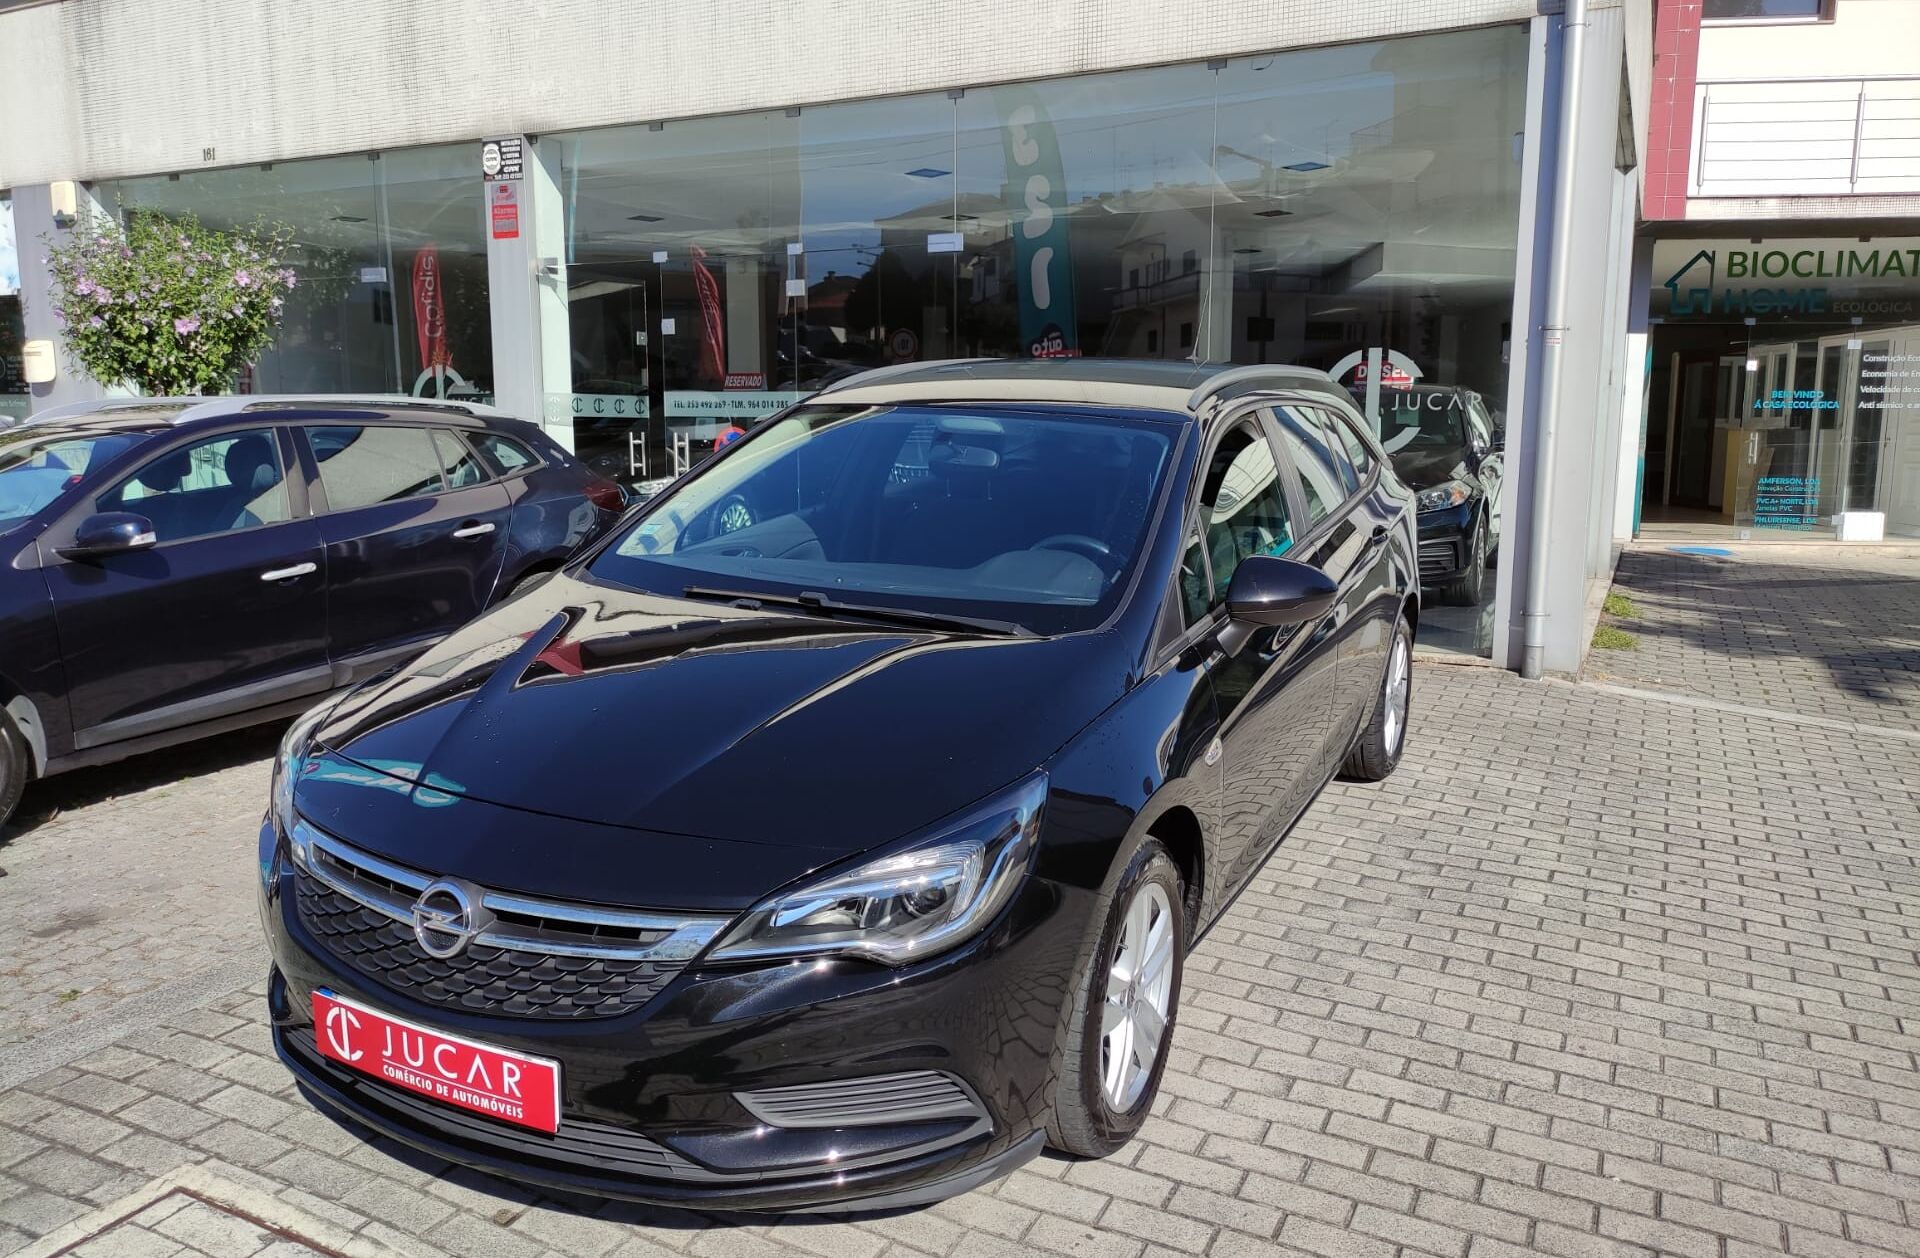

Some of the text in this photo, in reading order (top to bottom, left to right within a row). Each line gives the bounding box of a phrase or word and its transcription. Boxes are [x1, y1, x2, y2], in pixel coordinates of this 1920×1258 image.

[203, 147, 215, 161] 161
[420, 255, 443, 338] Cofidis
[1724, 288, 1827, 313] HOME
[1861, 370, 1898, 378] Economia
[724, 375, 763, 387] RESERVADO
[1793, 390, 1824, 399] VINDO
[1860, 385, 1901, 393] Velocidade
[748, 400, 760, 409] 964
[762, 400, 774, 409] 014
[1391, 391, 1482, 412] JUCAR
[1762, 400, 1786, 409] CASA
[1857, 401, 1875, 409] Anti
[381, 1025, 522, 1098] JUCAR
[382, 1063, 524, 1119] COMÉRCIO DE AUTOMÓVEIS
